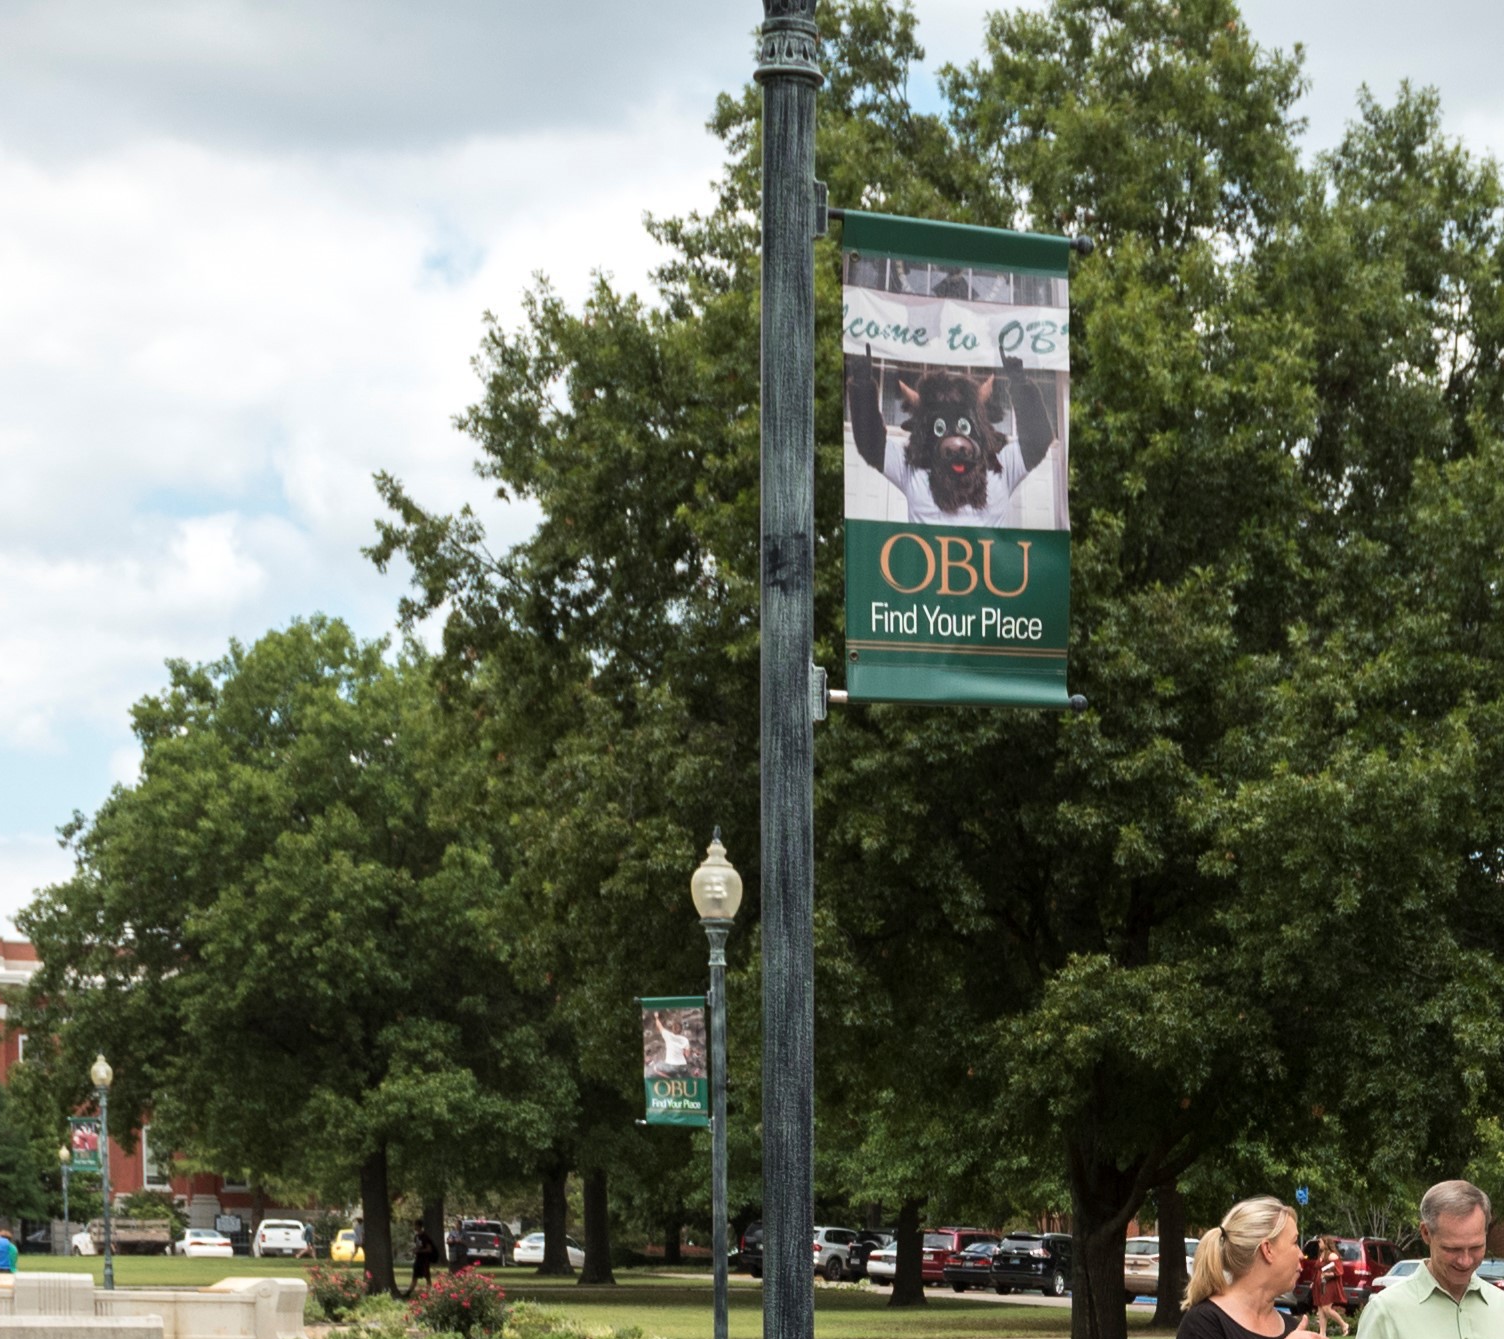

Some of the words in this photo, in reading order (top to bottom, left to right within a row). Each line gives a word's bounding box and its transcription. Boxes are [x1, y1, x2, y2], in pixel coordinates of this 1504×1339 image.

[947, 323, 980, 350] to
[999, 319, 1069, 354] OB
[880, 534, 1031, 597] OBU
[871, 602, 917, 635] Find
[923, 605, 975, 637] Your
[981, 608, 1042, 640] Place
[652, 1098, 666, 1108] Find
[667, 1099, 682, 1109] Your
[683, 1100, 701, 1109] Place
[654, 1080, 697, 1097] OBU
